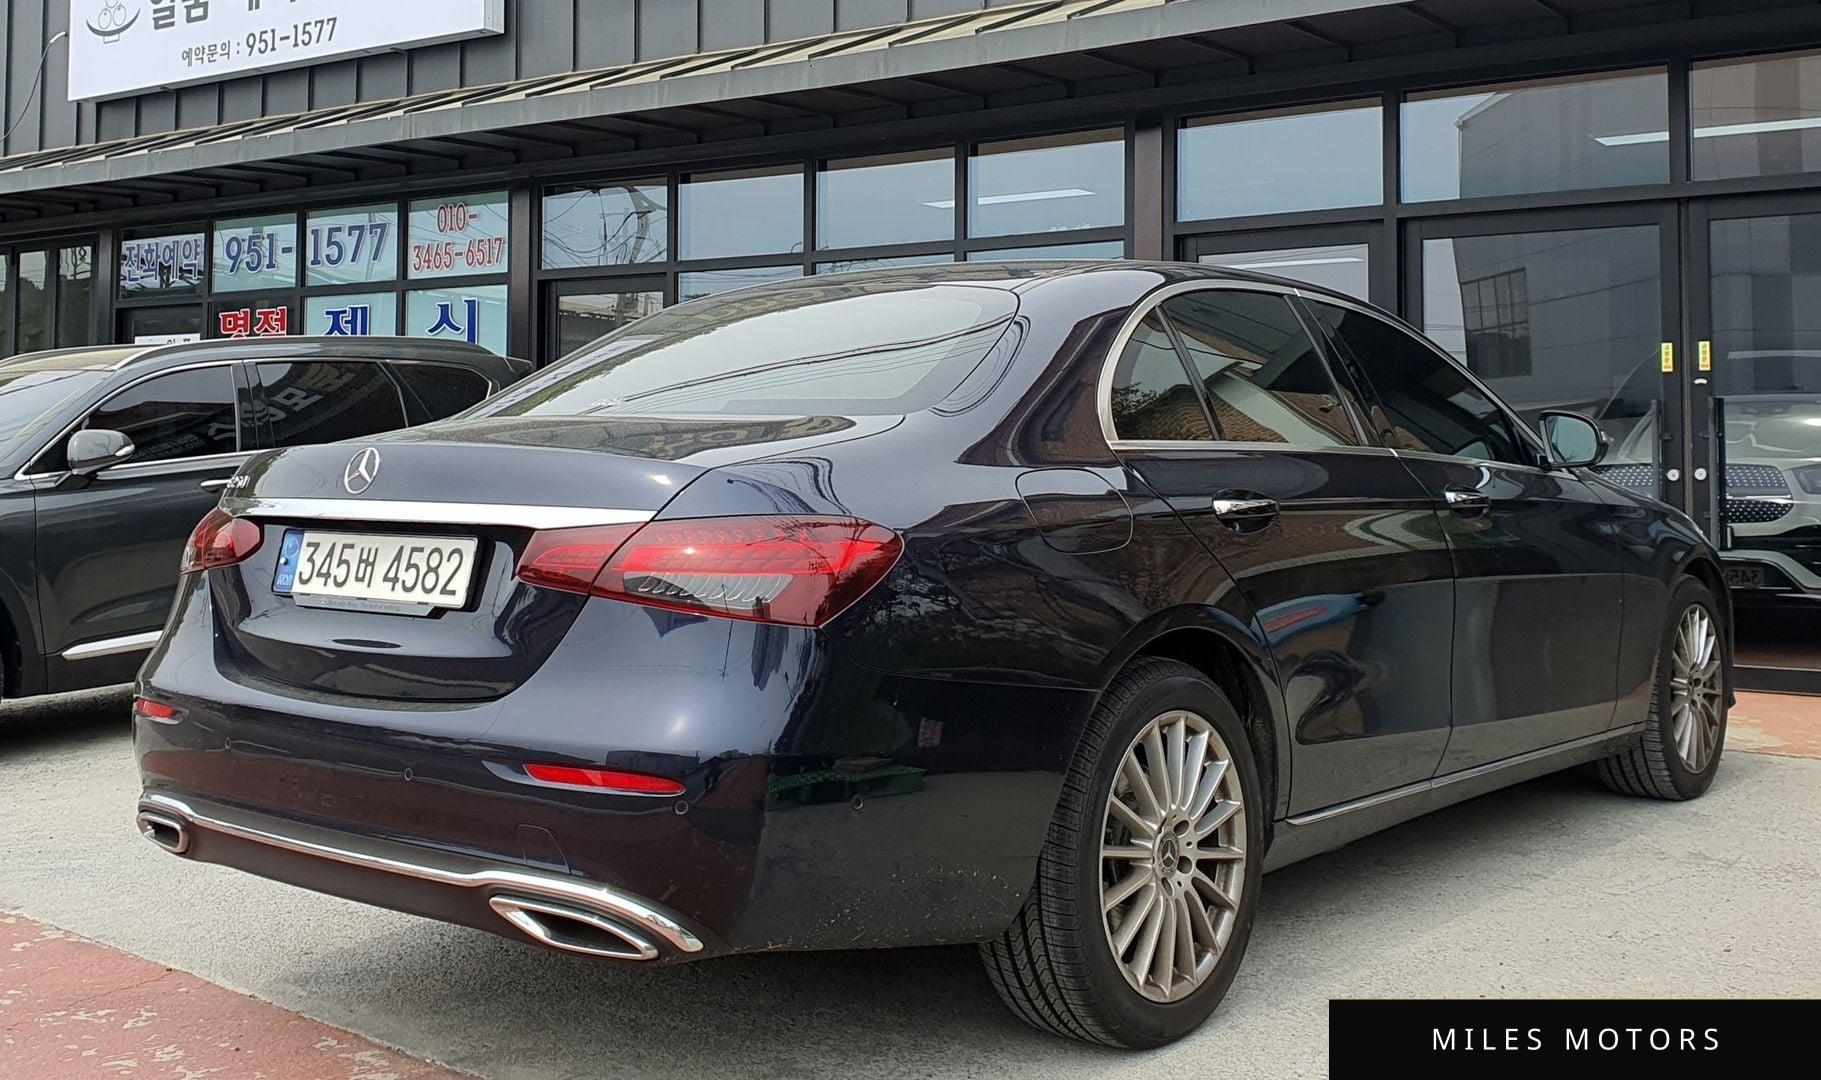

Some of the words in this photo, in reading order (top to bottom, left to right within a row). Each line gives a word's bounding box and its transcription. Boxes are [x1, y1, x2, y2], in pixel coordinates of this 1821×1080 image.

[181, 40, 231, 67] 예약문의
[246, 16, 338, 57] 951-1577
[436, 202, 479, 235] 010-
[125, 238, 201, 284] 전화예약
[225, 232, 293, 276] 951-
[310, 222, 389, 268] 1577
[412, 236, 505, 273] 3465-6517
[382, 545, 464, 596] 4582
